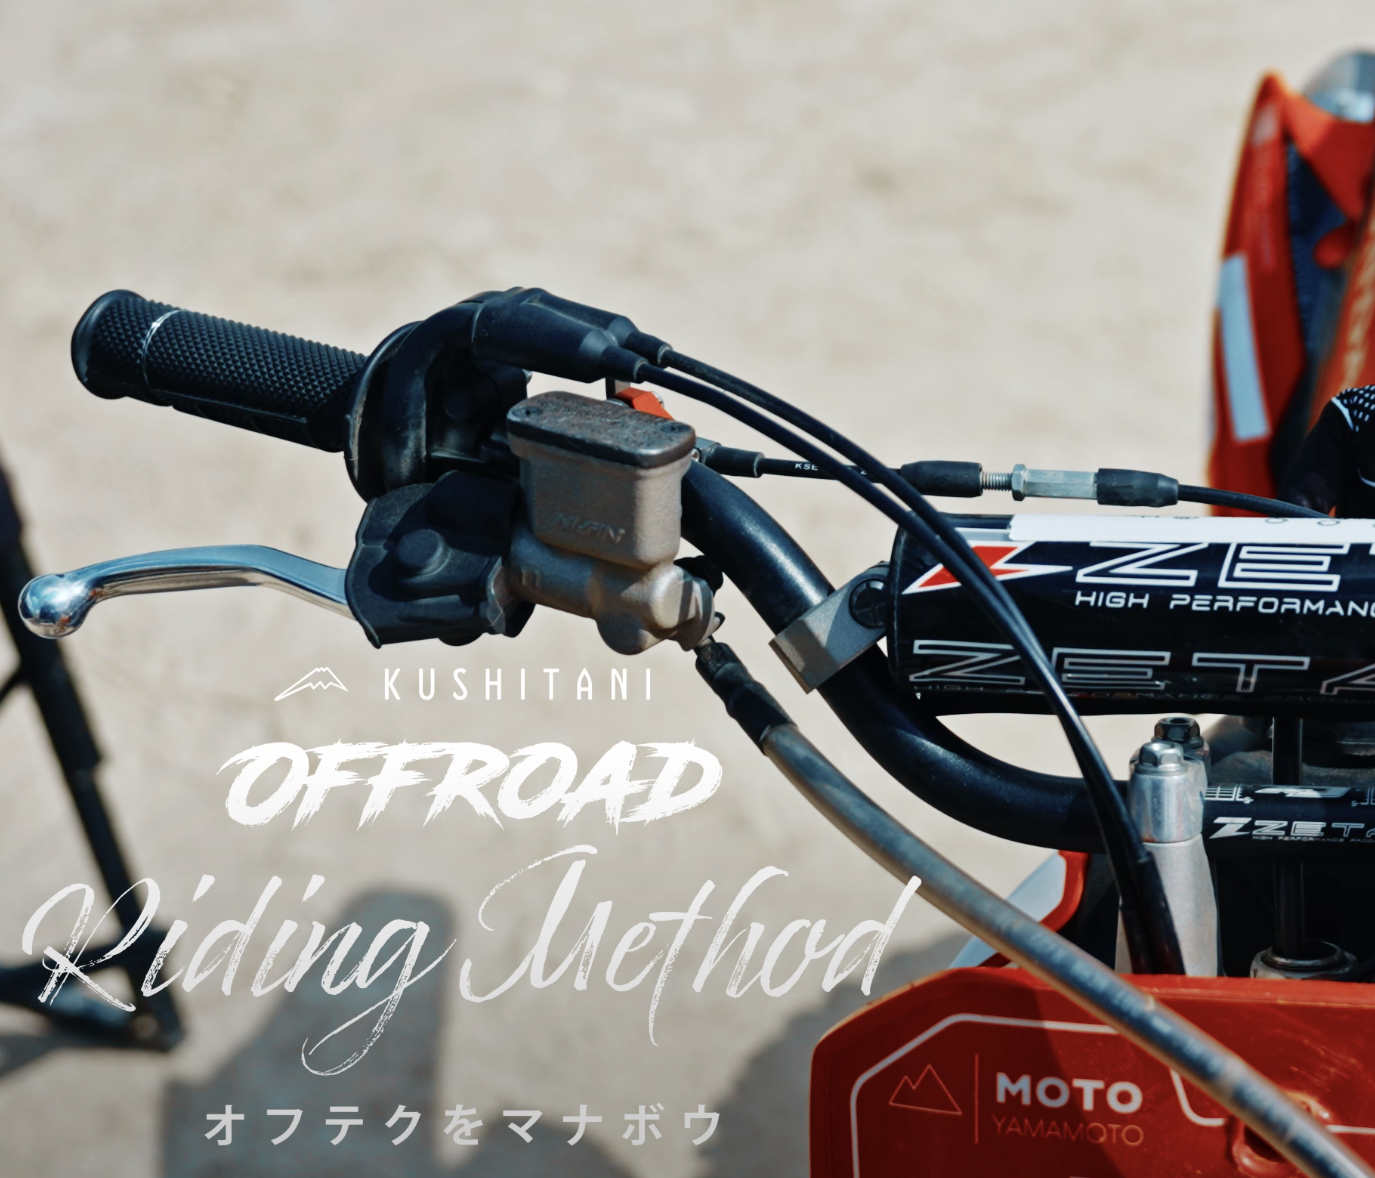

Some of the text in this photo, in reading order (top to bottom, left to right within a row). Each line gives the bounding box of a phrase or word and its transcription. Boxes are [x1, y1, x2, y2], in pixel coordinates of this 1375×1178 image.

[1075, 591, 1150, 608] HIGH
[996, 1071, 1144, 1115] MOTO
[992, 1113, 1145, 1147] YAMAMOTO
